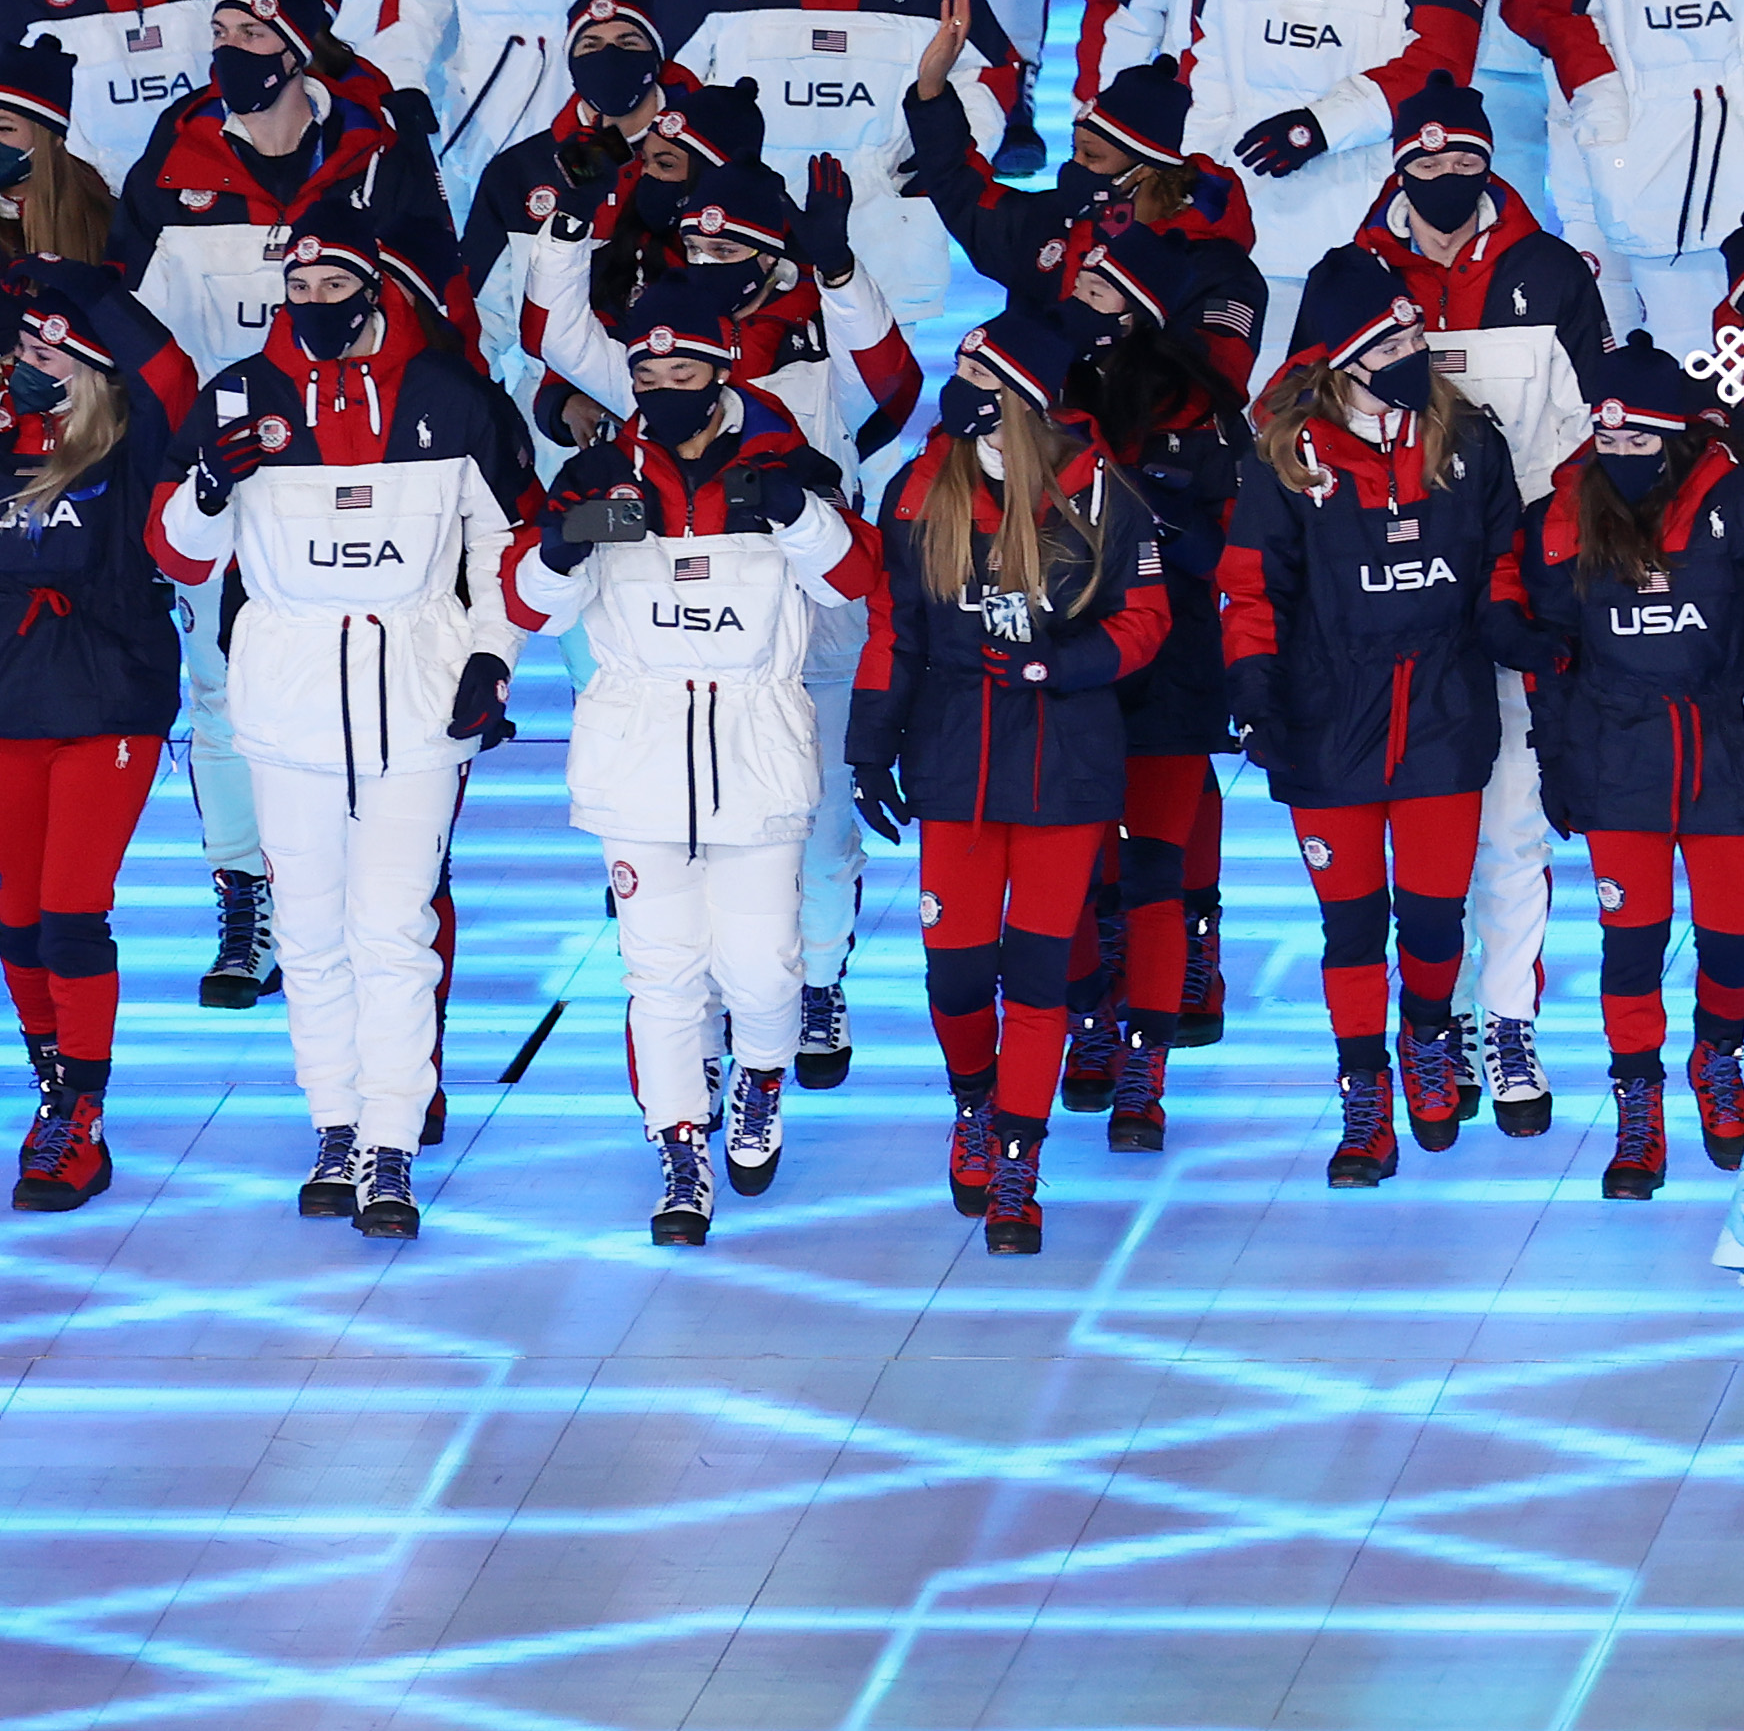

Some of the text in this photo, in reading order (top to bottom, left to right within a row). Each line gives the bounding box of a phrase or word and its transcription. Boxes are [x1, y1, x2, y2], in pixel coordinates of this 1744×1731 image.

[1645, 0, 1731, 28] USA
[1264, 20, 1341, 50] USA
[109, 72, 194, 105] USA
[784, 81, 875, 108] USA
[308, 541, 405, 568] USA
[1359, 558, 1456, 591] USA
[652, 602, 745, 632] USA
[1609, 604, 1706, 635] USA
